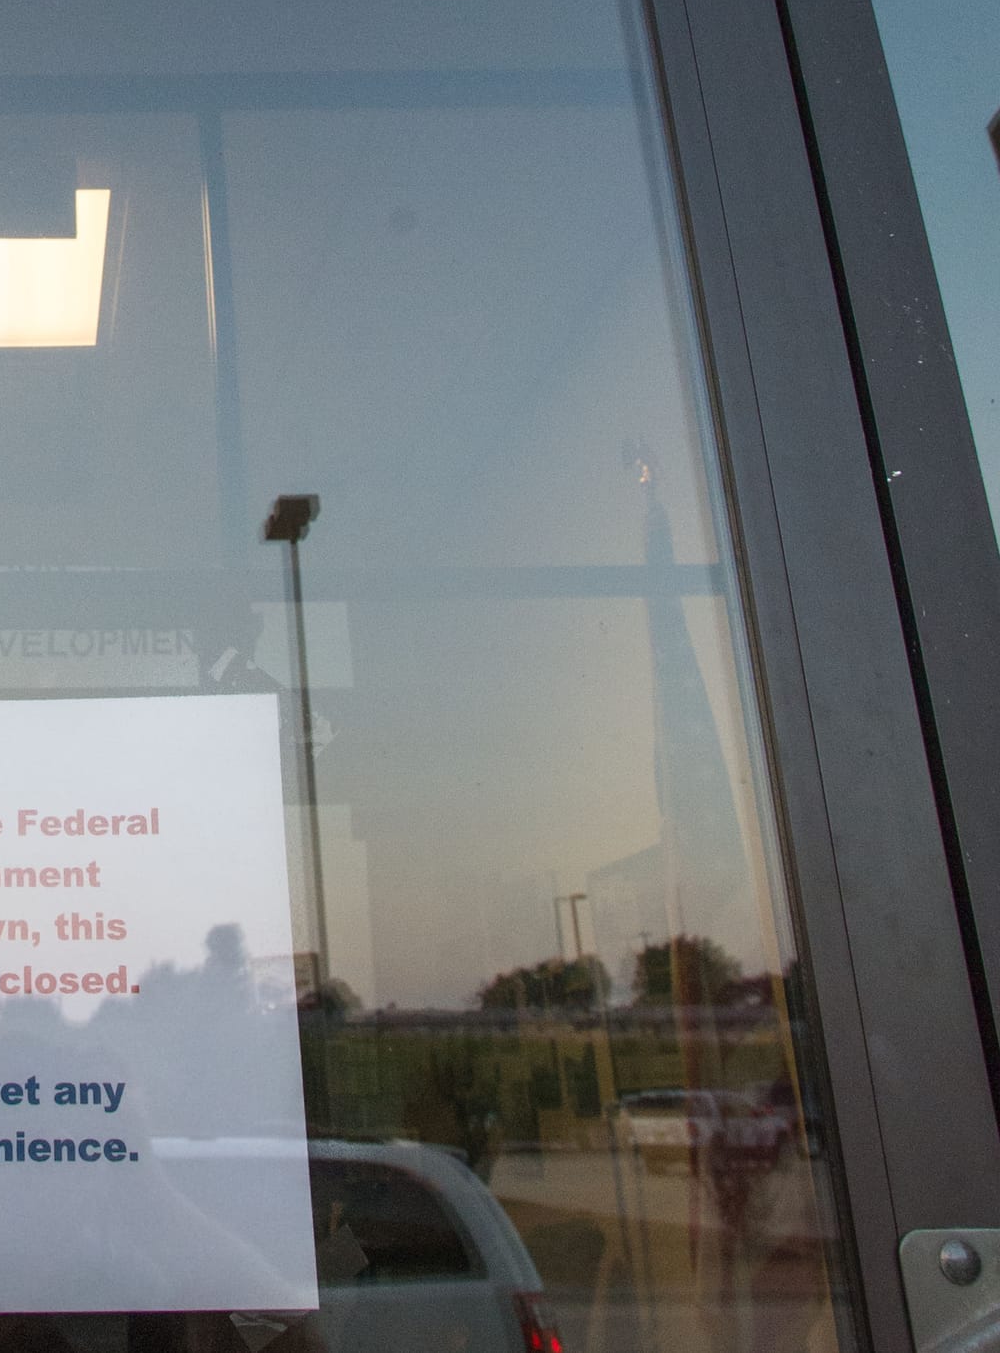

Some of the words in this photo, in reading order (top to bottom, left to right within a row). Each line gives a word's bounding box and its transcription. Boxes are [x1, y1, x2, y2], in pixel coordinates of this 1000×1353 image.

[17, 808, 160, 836] Federal
[54, 912, 127, 941] this
[0, 965, 141, 995] closed.
[54, 1081, 126, 1113] any
